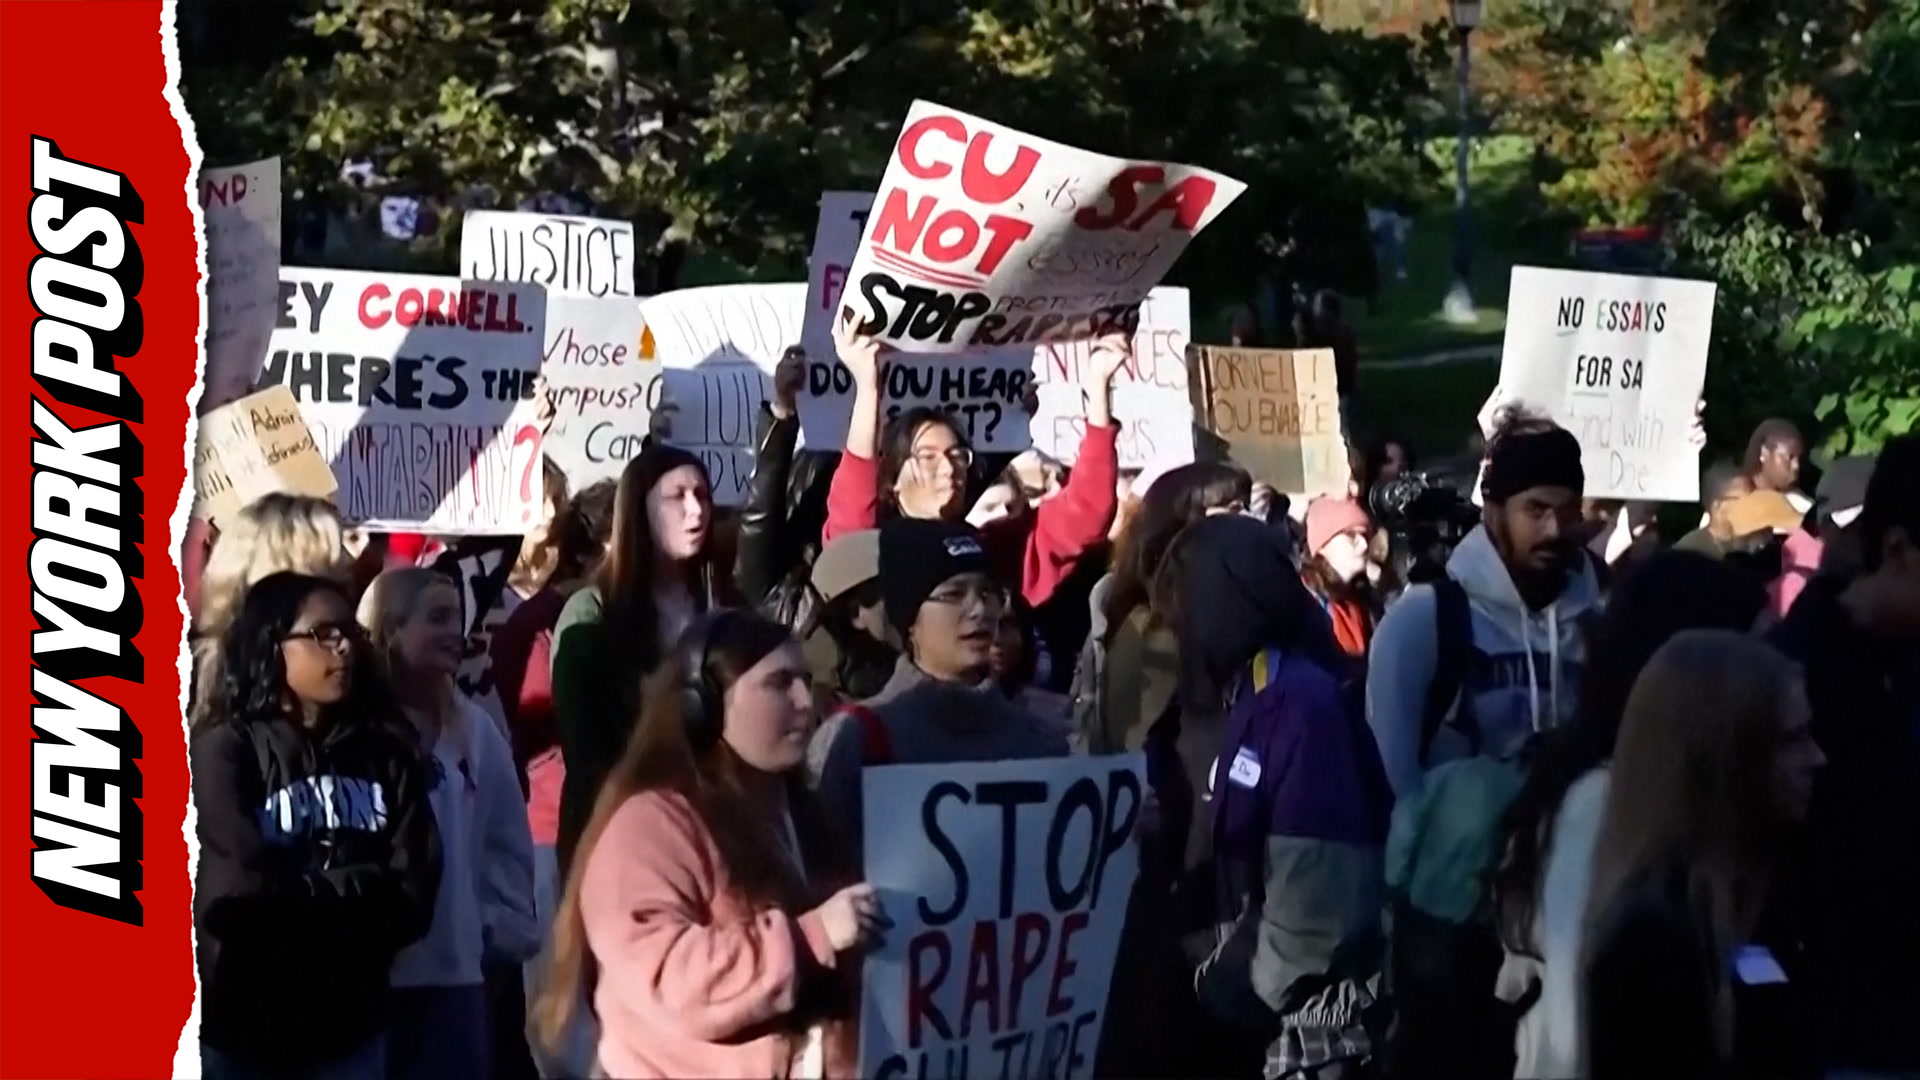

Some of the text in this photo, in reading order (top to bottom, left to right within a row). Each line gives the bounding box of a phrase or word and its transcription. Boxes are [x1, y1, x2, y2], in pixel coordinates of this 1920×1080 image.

[870, 187, 1034, 276] NOT
[1074, 166, 1217, 232] SA
[473, 217, 630, 298] JUSTICE
[276, 279, 334, 334] EY
[357, 282, 534, 334] CORNELL.
[843, 272, 991, 343] STOP
[1557, 297, 1667, 333] NO ESSAYS
[810, 363, 852, 397] DO
[939, 366, 1027, 404] HEAR
[1575, 354, 1644, 390] FOR SA
[1214, 398, 1331, 438] OU ENABLE
[917, 767, 1142, 926] STOP
[906, 911, 1090, 1049] RAPE
